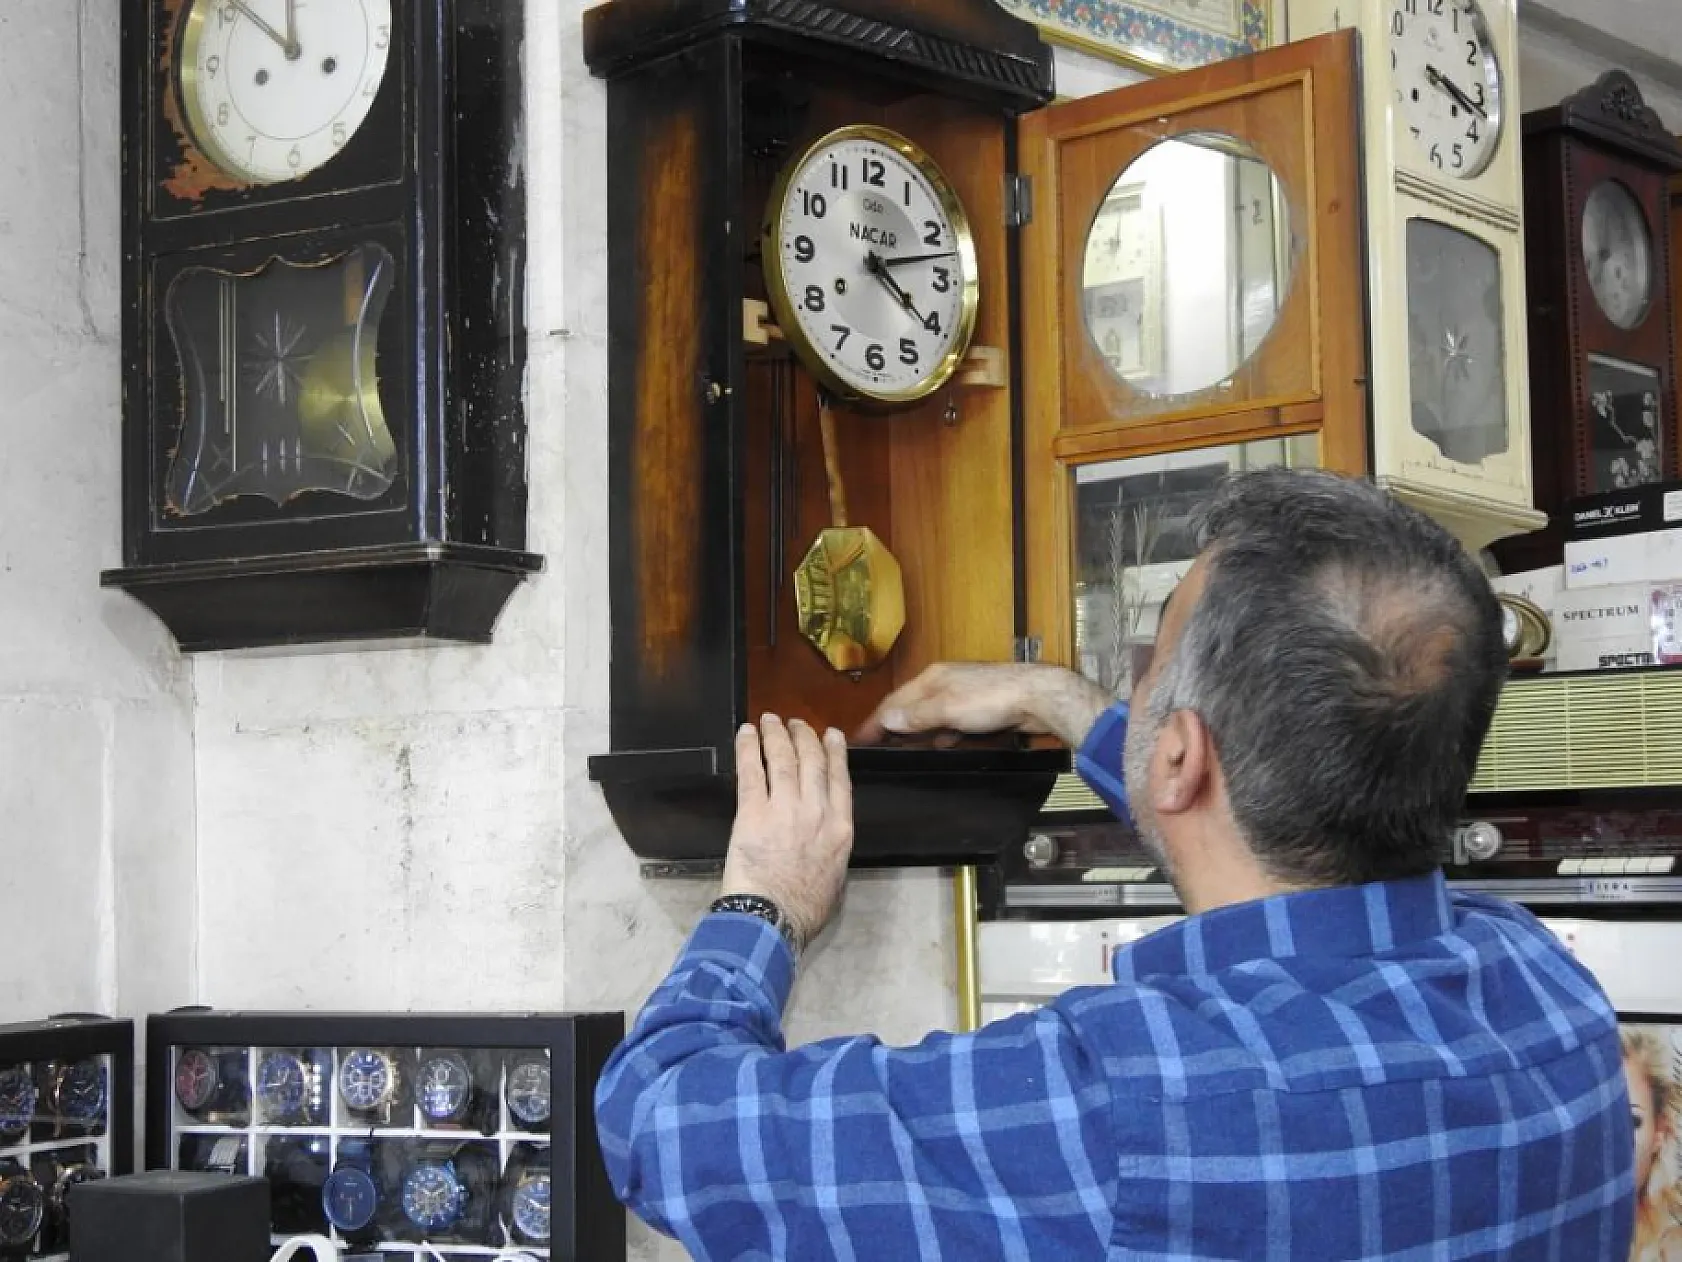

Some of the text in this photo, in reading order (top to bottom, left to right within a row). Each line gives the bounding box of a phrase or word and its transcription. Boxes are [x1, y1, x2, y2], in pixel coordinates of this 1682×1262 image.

[1453, 8, 1459, 33] 1
[1466, 40, 1477, 66] 2
[205, 55, 220, 79] 9
[332, 121, 347, 146] 5
[1465, 118, 1479, 144] 4
[287, 143, 301, 168] 6
[1452, 143, 1463, 168] 5
[831, 161, 848, 190] 11
[862, 157, 886, 187] 12
[803, 190, 827, 219] 10
[903, 181, 910, 206] 1
[850, 221, 897, 249] NACAR
[923, 220, 941, 247] 2
[794, 234, 815, 263] 9
[932, 266, 949, 293] 3
[804, 285, 825, 312] 8
[922, 311, 941, 336] 4
[831, 324, 850, 350] 7
[865, 344, 885, 370] 6
[899, 338, 919, 365] 5
[1563, 605, 1639, 621] SPECTRUM
